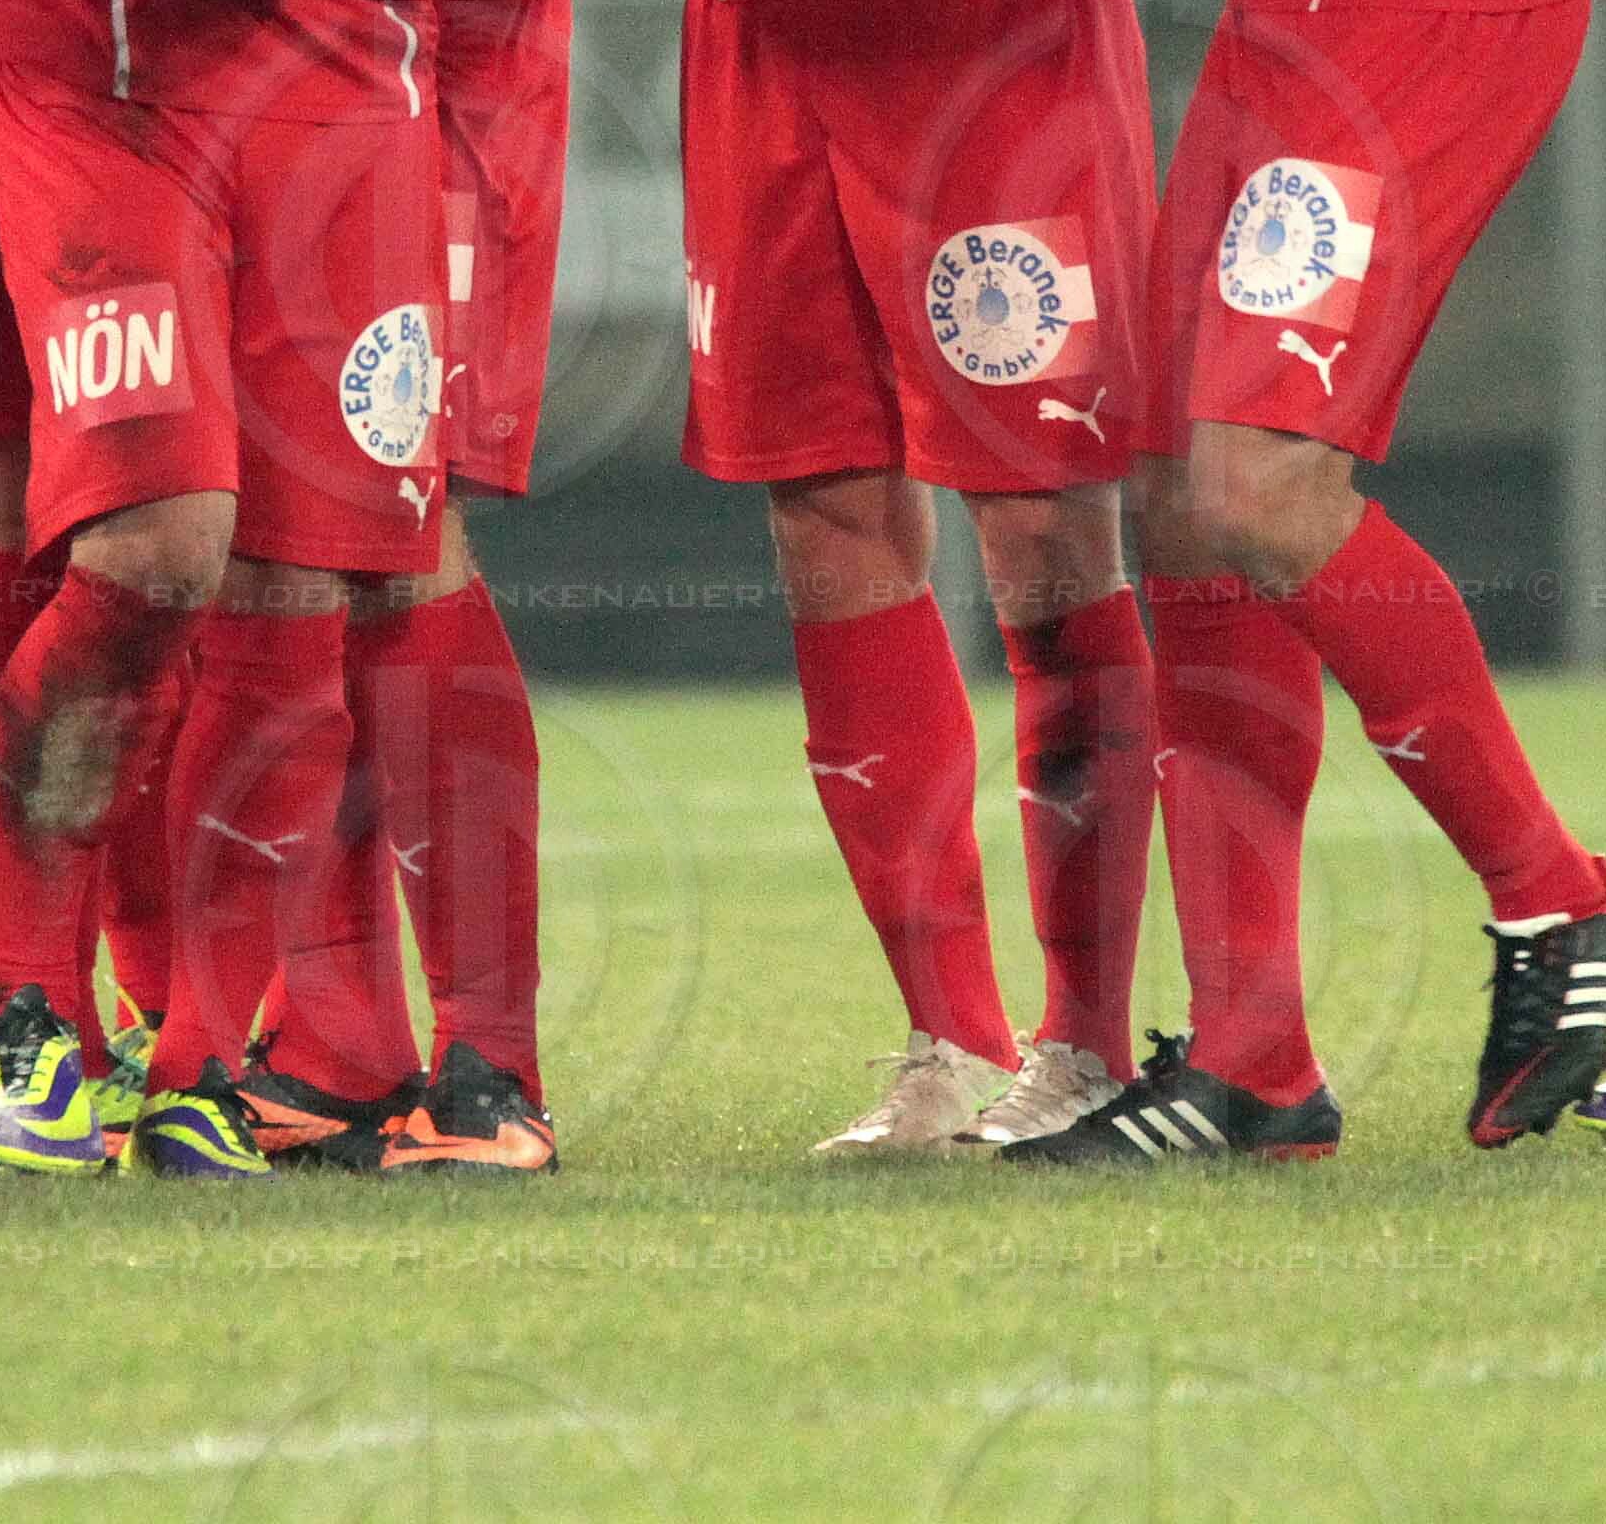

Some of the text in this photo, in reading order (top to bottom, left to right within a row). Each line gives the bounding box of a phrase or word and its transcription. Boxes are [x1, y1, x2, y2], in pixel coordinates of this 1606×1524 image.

[1269, 167, 1336, 279] Beranek
[931, 235, 1069, 344] ERGE Beranek
[1229, 279, 1294, 308] GmbH
[46, 298, 175, 415] NÖN
[346, 325, 394, 416] ERGE
[965, 348, 1038, 378] GmbH
